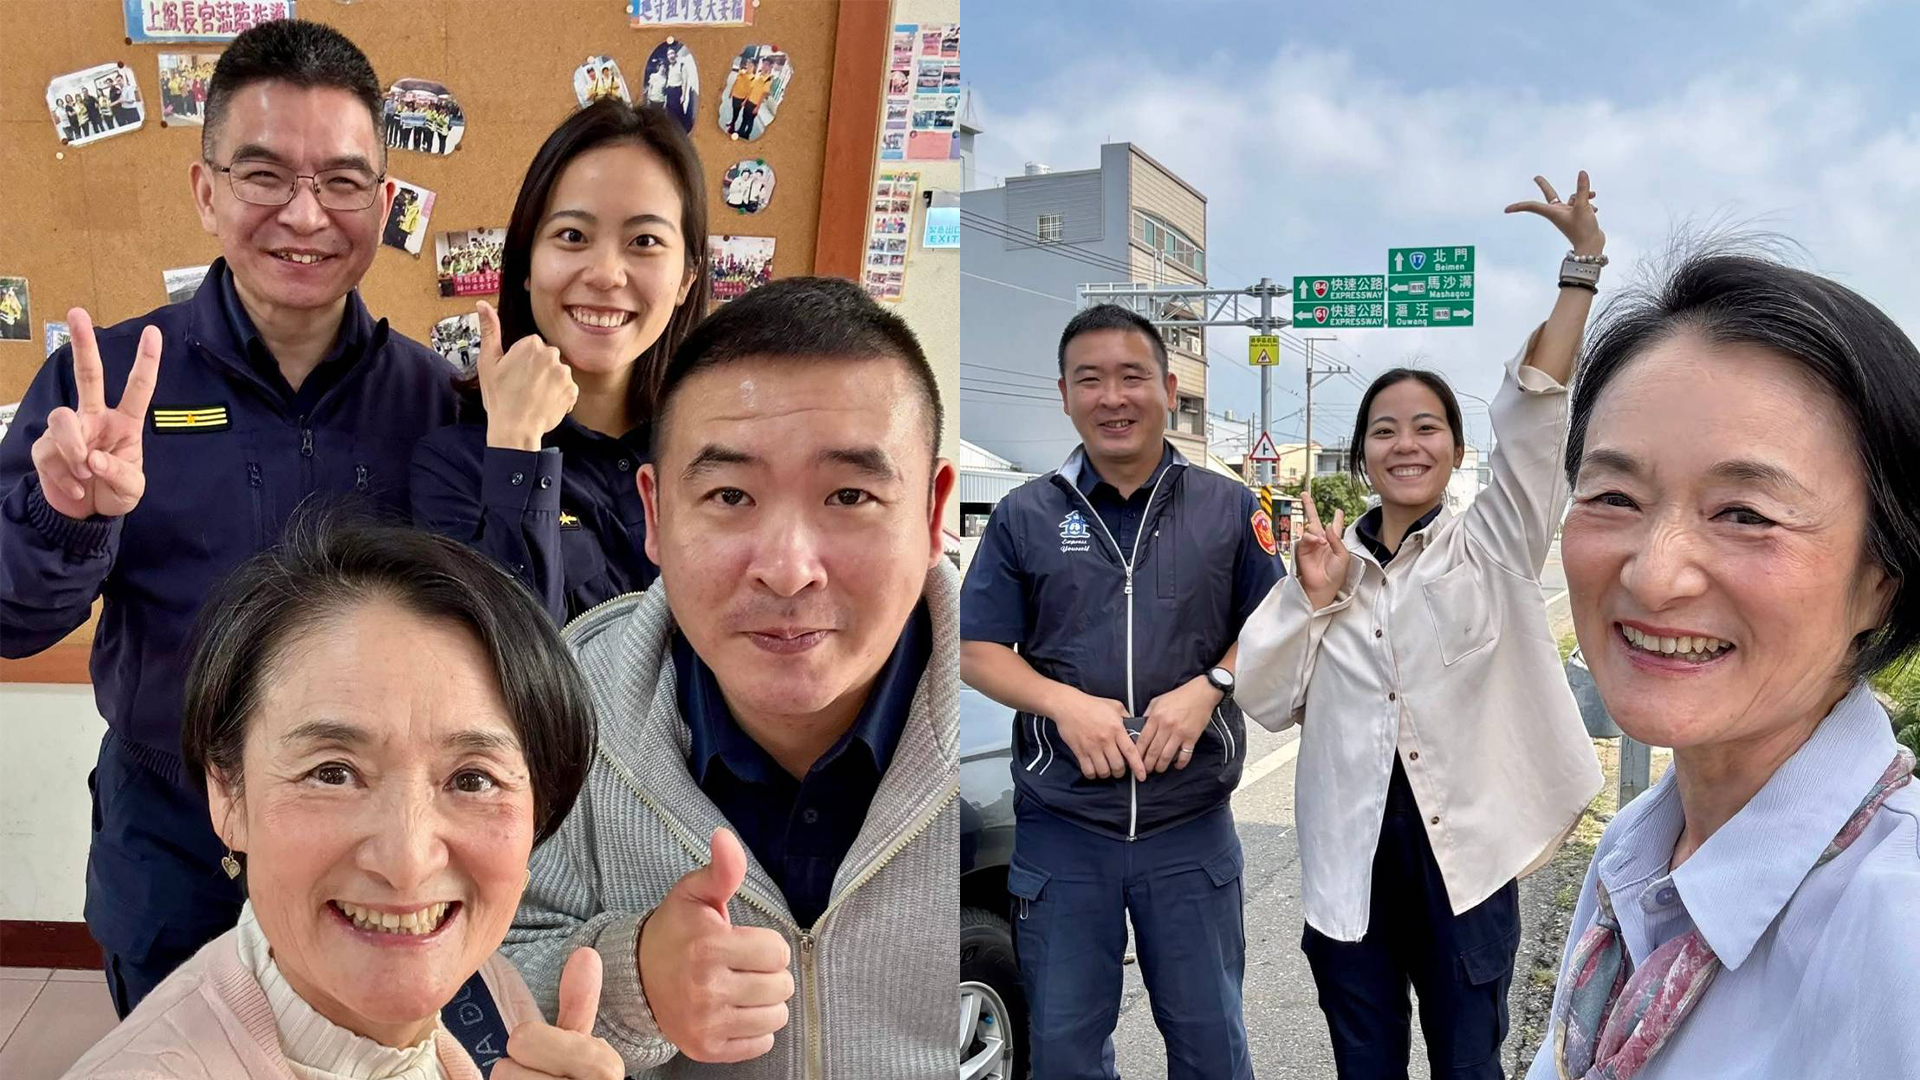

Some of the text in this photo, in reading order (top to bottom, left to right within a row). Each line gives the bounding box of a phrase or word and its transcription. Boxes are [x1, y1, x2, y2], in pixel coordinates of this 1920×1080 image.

[930, 235, 959, 243] EXIT
[1412, 254, 1423, 263] 17
[1433, 248, 1467, 262] 北門
[1434, 263, 1465, 271] Beimen
[1315, 282, 1326, 290] 84
[1330, 277, 1383, 291] 快速公路
[1427, 275, 1472, 289] 馬沙溝
[1330, 291, 1383, 299] EXPRESSWAY
[1429, 291, 1470, 299] Mashagou
[1316, 309, 1326, 318] 61
[1330, 304, 1383, 317] 快速公路
[1395, 303, 1429, 317] 漚汪
[1330, 318, 1383, 326] EXPRESSWAY
[1396, 318, 1428, 327] Ouwang
